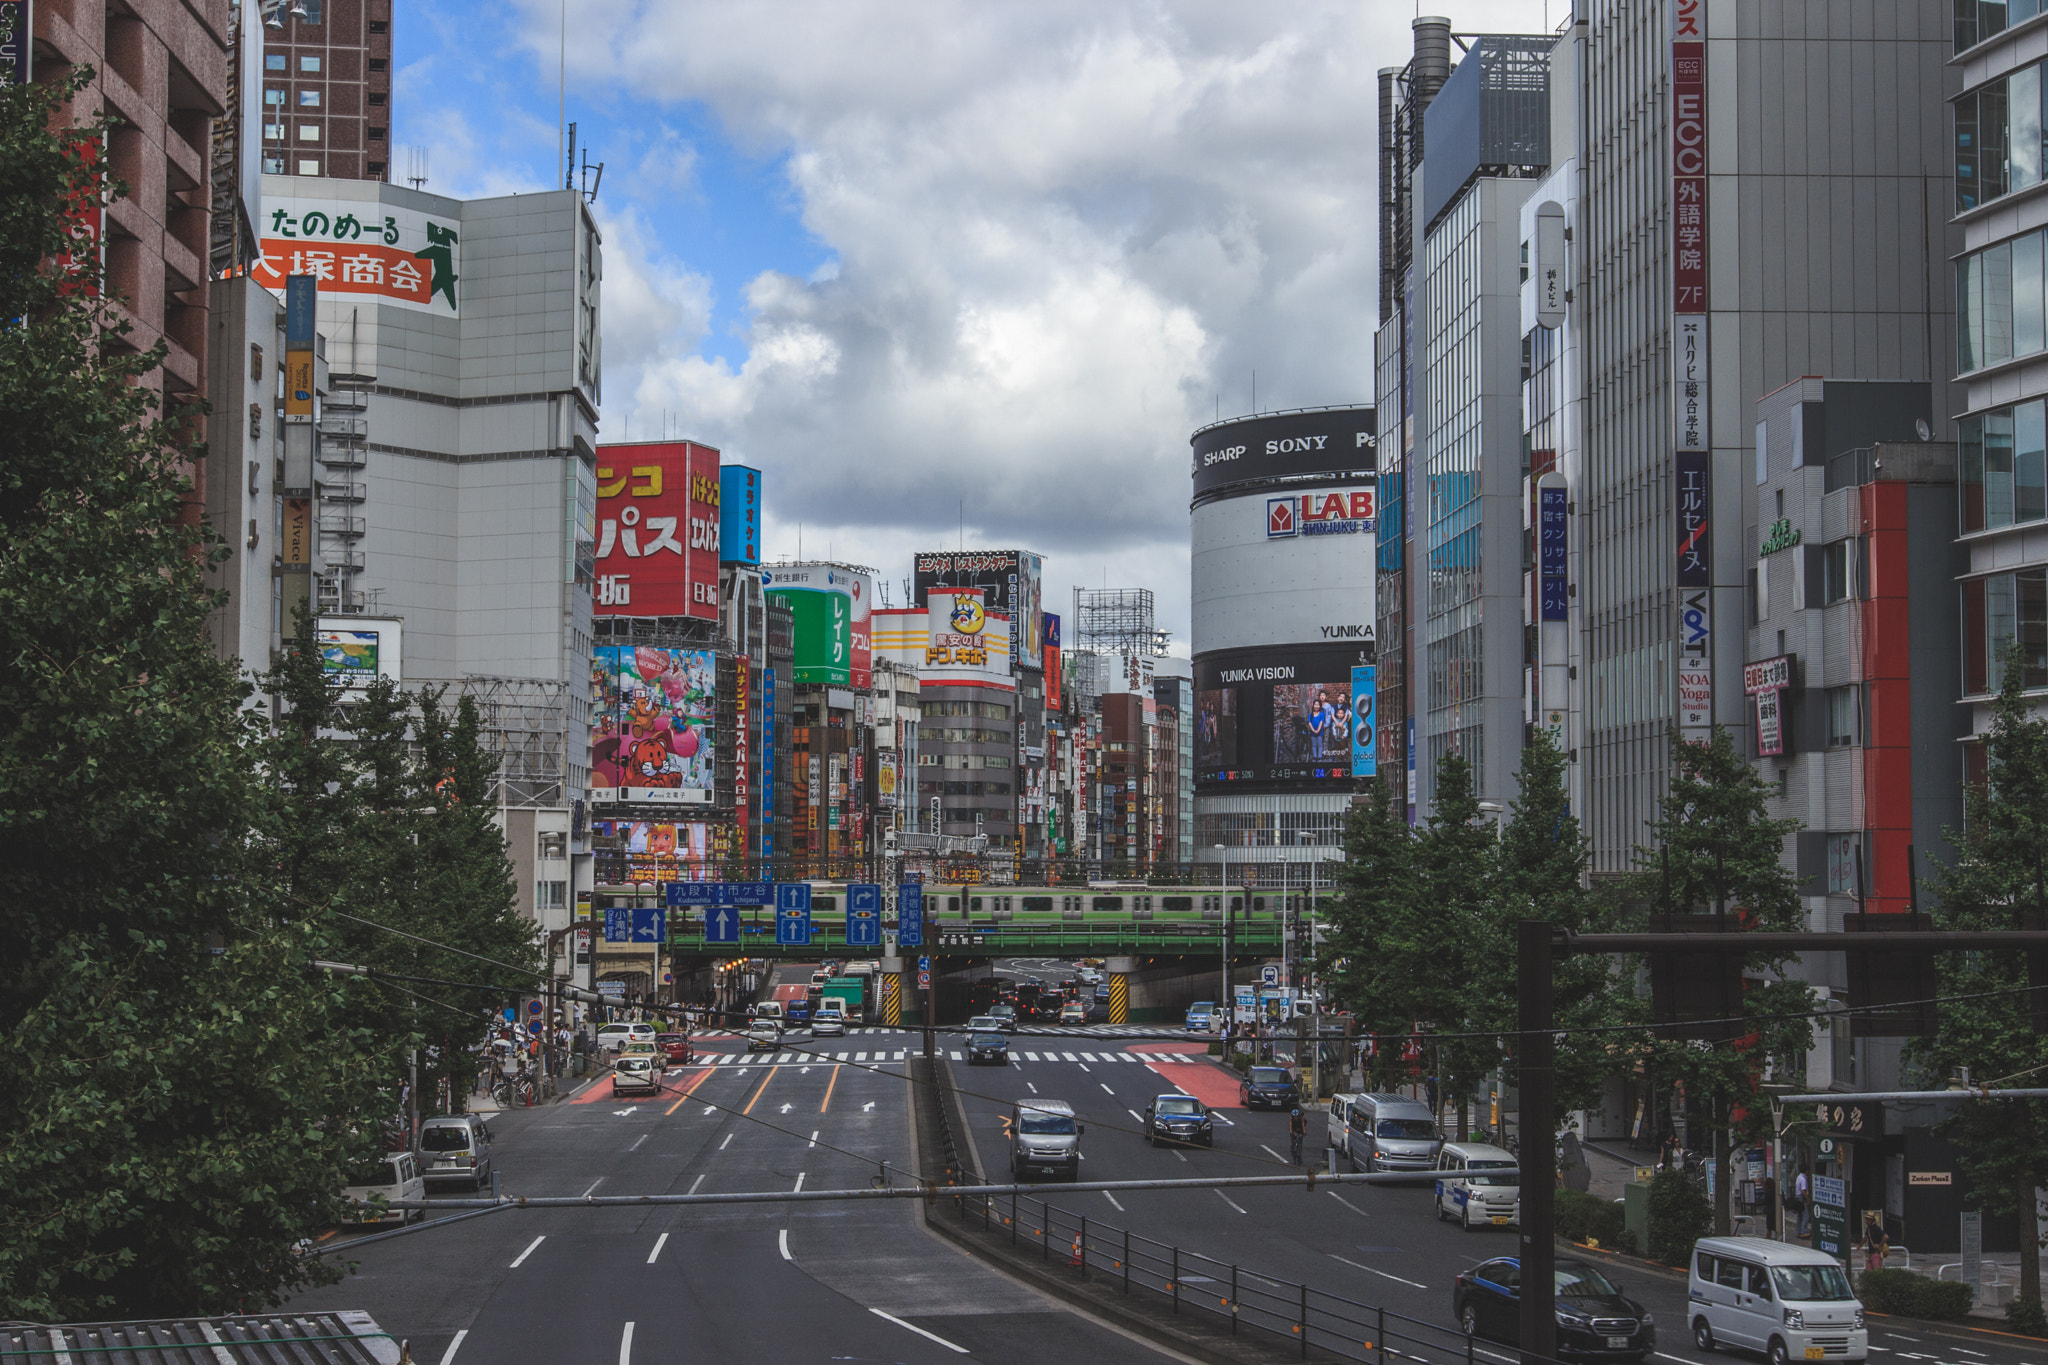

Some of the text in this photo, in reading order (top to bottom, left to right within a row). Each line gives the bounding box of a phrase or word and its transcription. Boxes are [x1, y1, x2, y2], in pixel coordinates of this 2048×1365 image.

[1678, 61, 1699, 69] ECC
[1677, 94, 1702, 174] ECC
[272, 208, 400, 246] たのめーる
[1679, 181, 1701, 270] 外語学院
[254, 248, 422, 293] 大塚商会
[1679, 287, 1702, 303] 7F
[1685, 335, 1699, 446] ハクビ総合学院
[1266, 435, 1328, 455] SONY
[1204, 445, 1247, 466] SHARP
[691, 469, 720, 507] パチンコ
[595, 505, 682, 558] パス
[1302, 521, 1357, 535] SHINJUKU
[1681, 471, 1701, 572] エルセーヌ
[292, 514, 303, 562] Vivace
[691, 511, 720, 553] エスパス
[1543, 493, 1554, 609] 新宿クリニック
[1555, 493, 1566, 609] スキンサポート
[919, 555, 1017, 573] エンタメ レストランタワー
[774, 573, 809, 583] 新生銀行
[694, 582, 717, 606] 日拓
[833, 597, 843, 663] レイク
[1321, 624, 1374, 638] YUNIKA
[850, 631, 870, 651] アコム
[1689, 659, 1701, 667] 4F
[1220, 666, 1295, 683] YUNIKA VISION
[1680, 674, 1710, 685] NOA
[1680, 688, 1710, 701] Yoga
[1682, 703, 1709, 711] Studio
[1760, 702, 1777, 720] 歯科
[1689, 713, 1702, 722] 9F
[1353, 751, 1375, 767] global
[675, 885, 714, 896] 九段下
[734, 896, 760, 904] Ichigaya
[901, 888, 909, 917] Shinjuku
[908, 887, 919, 942] 新宿駅東口
